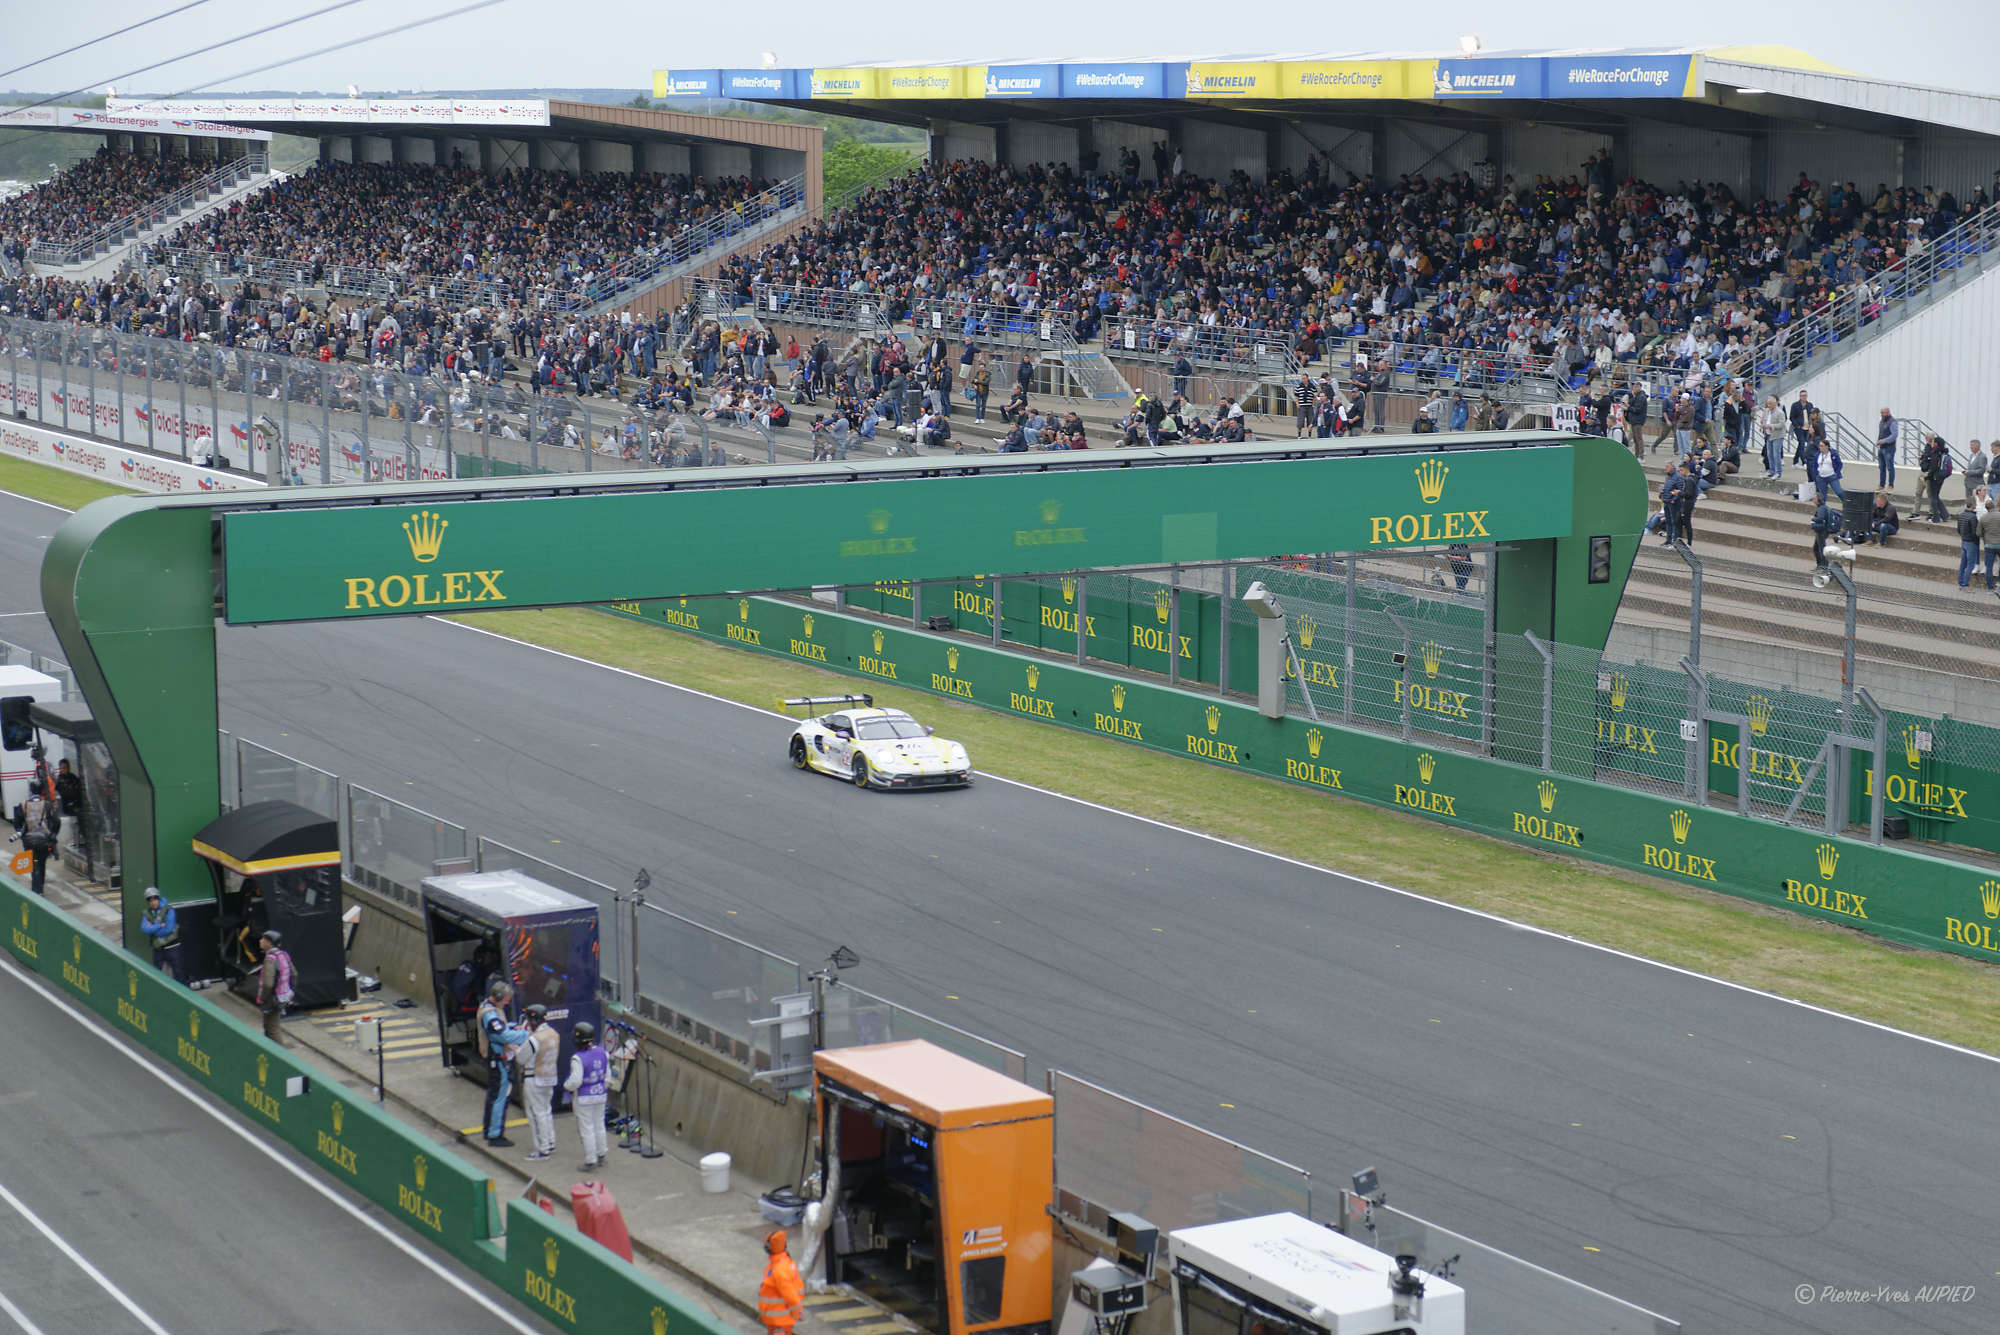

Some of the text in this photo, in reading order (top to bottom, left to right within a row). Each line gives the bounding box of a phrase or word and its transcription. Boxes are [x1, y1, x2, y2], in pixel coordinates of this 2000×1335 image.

[823, 80, 861, 89] MICHELIN
[998, 78, 1041, 89] MICHELIN
[1076, 73, 1145, 88] #WeRaceForChange
[1203, 75, 1256, 87] MICHELIN
[1300, 72, 1382, 88] #WeRaceForChange
[1454, 74, 1516, 87] MICHELIN
[1568, 67, 1669, 86] #WeRaceForChange
[193, 121, 256, 134] TotalEnergies
[1369, 510, 1491, 544] ROLEX
[344, 570, 507, 609] ROLEX
[667, 609, 699, 630] ROLEX
[954, 590, 1005, 620] ROLE
[727, 624, 760, 646] ROLEX
[790, 638, 827, 662] ROLEX
[859, 655, 897, 680] ROLEX
[931, 673, 974, 699] ROLEX
[1010, 692, 1055, 719] ROLEX
[1095, 712, 1143, 741] ROLEX
[1187, 734, 1239, 764] ROLEX
[1286, 758, 1343, 789] ROLEX
[1394, 784, 1457, 817] ROLEX
[1513, 811, 1581, 848] ROLEX
[1643, 844, 1717, 882] ROLEX
[1786, 878, 1868, 919] ROLEX
[12, 927, 38, 958] ROLEX
[1945, 916, 2000, 952] ROL
[63, 960, 91, 995] ROLEX
[117, 997, 148, 1033] ROLEX
[177, 1036, 211, 1076] ROLEX
[243, 1081, 281, 1123] ROLEX
[317, 1130, 358, 1175] ROLEX
[399, 1183, 443, 1233] ROLEX
[524, 1268, 577, 1324] ROLEX
